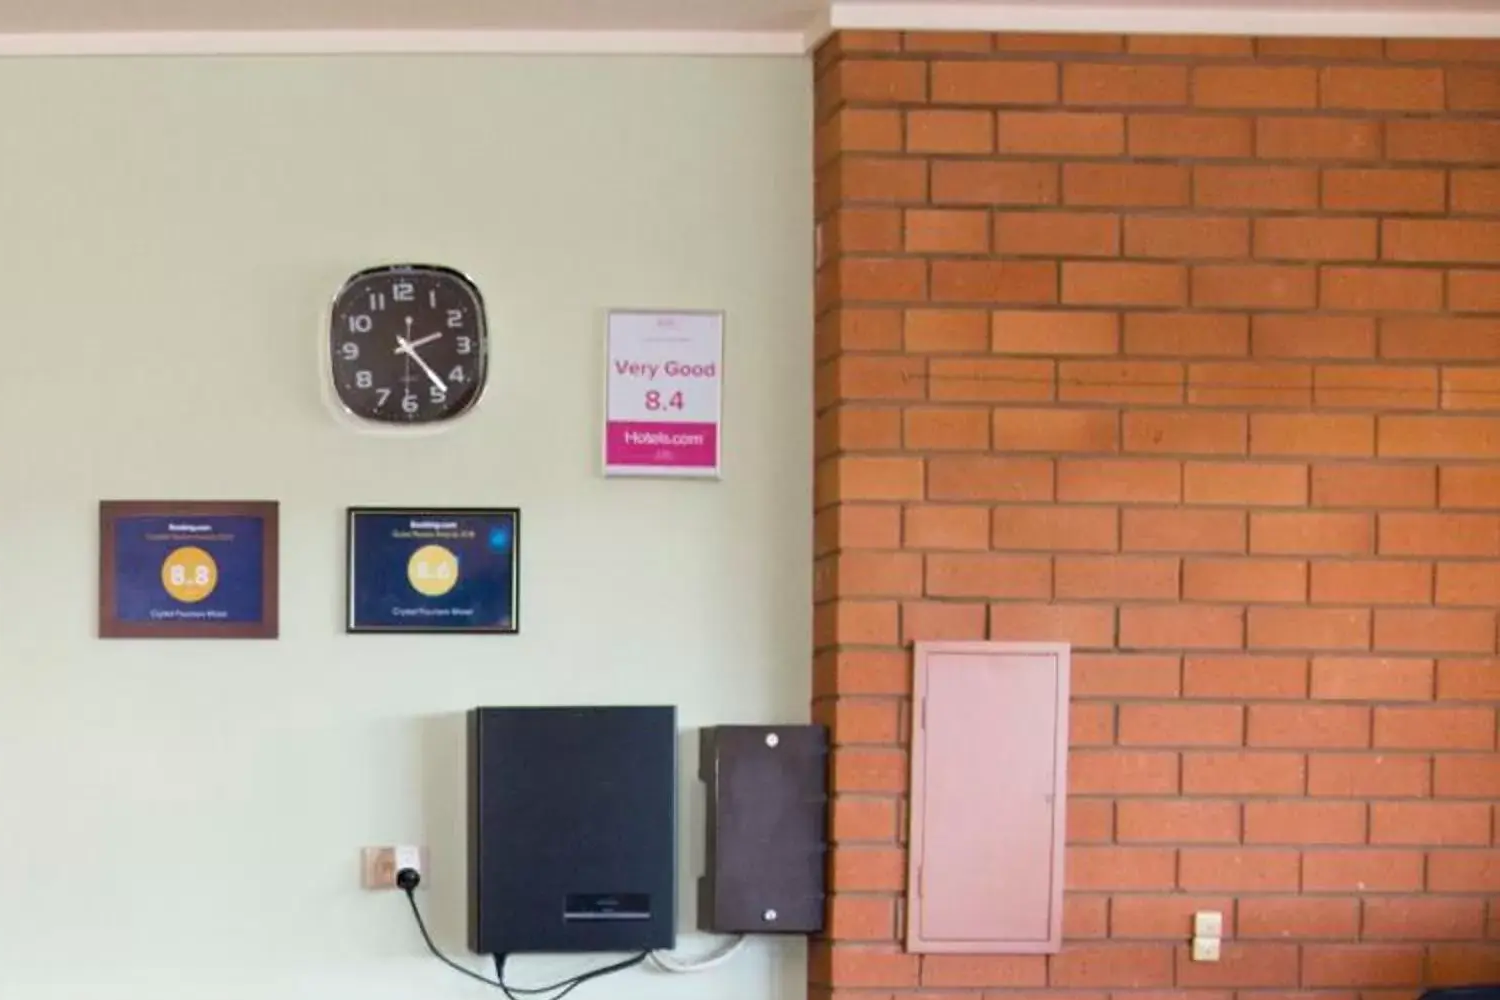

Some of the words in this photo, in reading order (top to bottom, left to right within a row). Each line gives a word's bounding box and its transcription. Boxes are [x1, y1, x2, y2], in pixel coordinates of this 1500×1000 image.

[393, 283, 414, 301] 12
[429, 290, 436, 308] 1
[369, 293, 385, 310] 11
[349, 315, 372, 333] 10
[447, 310, 463, 328] 2
[342, 342, 360, 360] 9
[456, 336, 471, 354] 3
[448, 366, 464, 383] 4
[615, 360, 660, 380] Very
[664, 360, 716, 377] Good
[355, 371, 372, 388] 8
[375, 388, 391, 407] 7
[402, 394, 418, 412] 6
[430, 386, 447, 403] 5
[644, 389, 684, 411] 8.4
[624, 431, 704, 446] Hotels.com
[170, 564, 210, 585] 8.8
